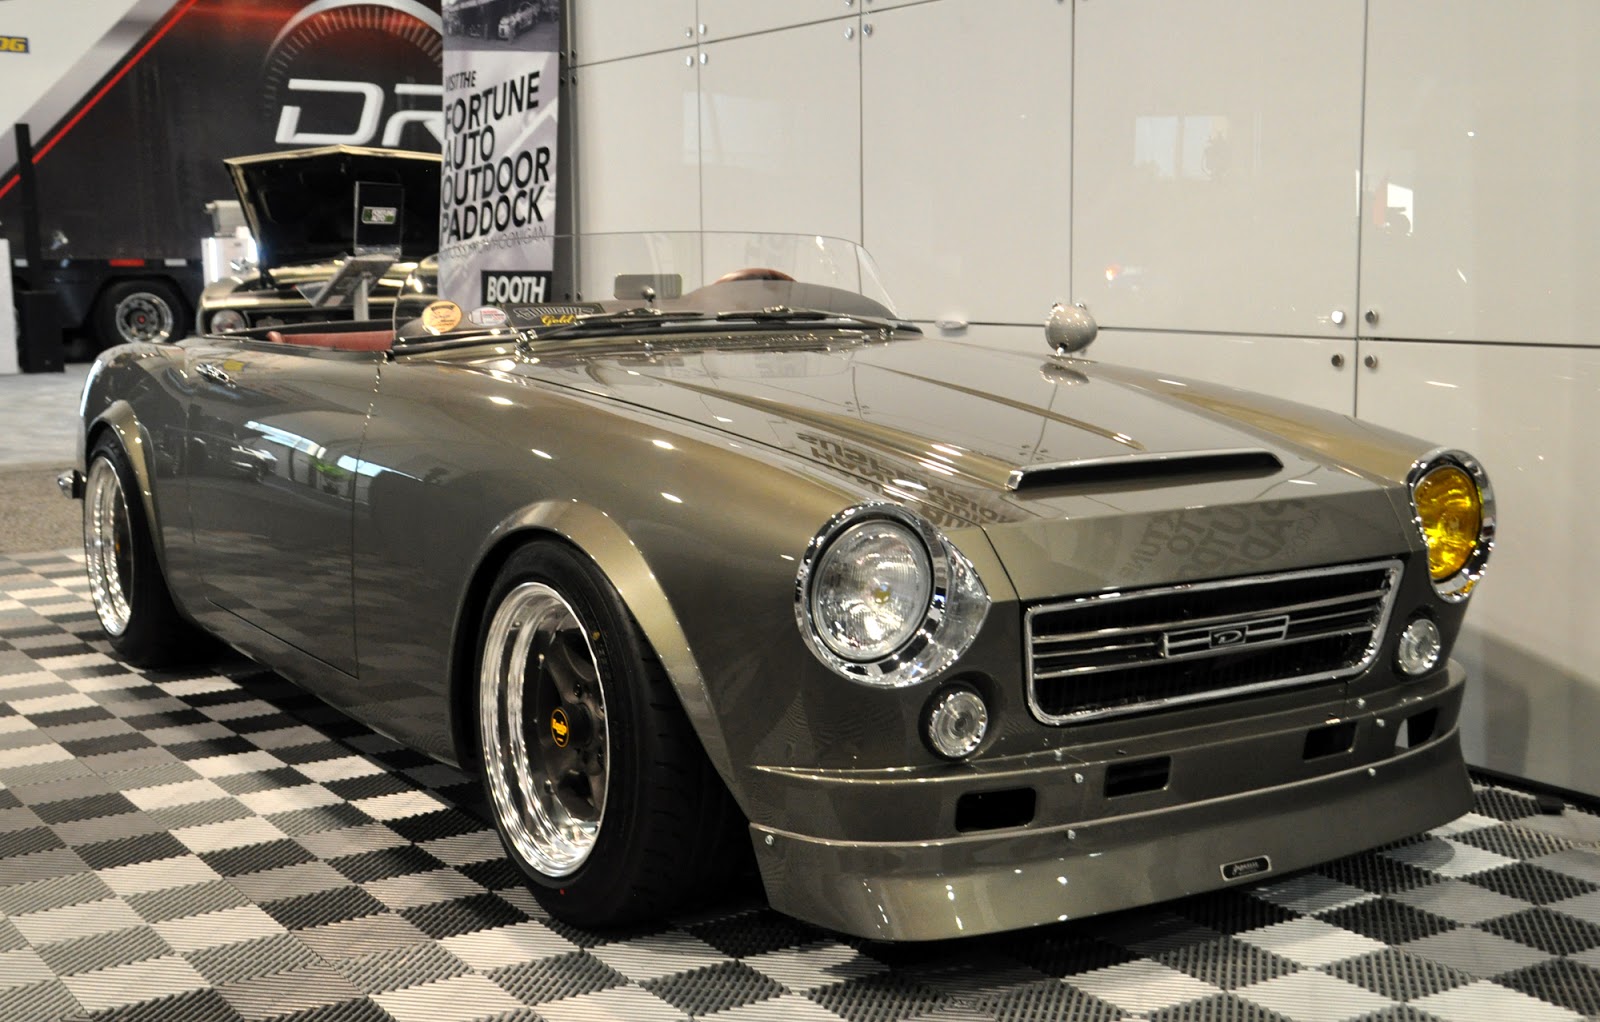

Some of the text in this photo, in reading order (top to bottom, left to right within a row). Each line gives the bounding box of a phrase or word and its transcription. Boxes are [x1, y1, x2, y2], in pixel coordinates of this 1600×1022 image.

[445, 70, 541, 140] FORTUNE
[460, 70, 477, 89] THE
[443, 125, 495, 177] AUTO
[442, 146, 550, 211] OUTDOOR
[440, 185, 546, 247] PADDOCK
[486, 275, 547, 304] BOOTH
[540, 313, 576, 327] Gold
